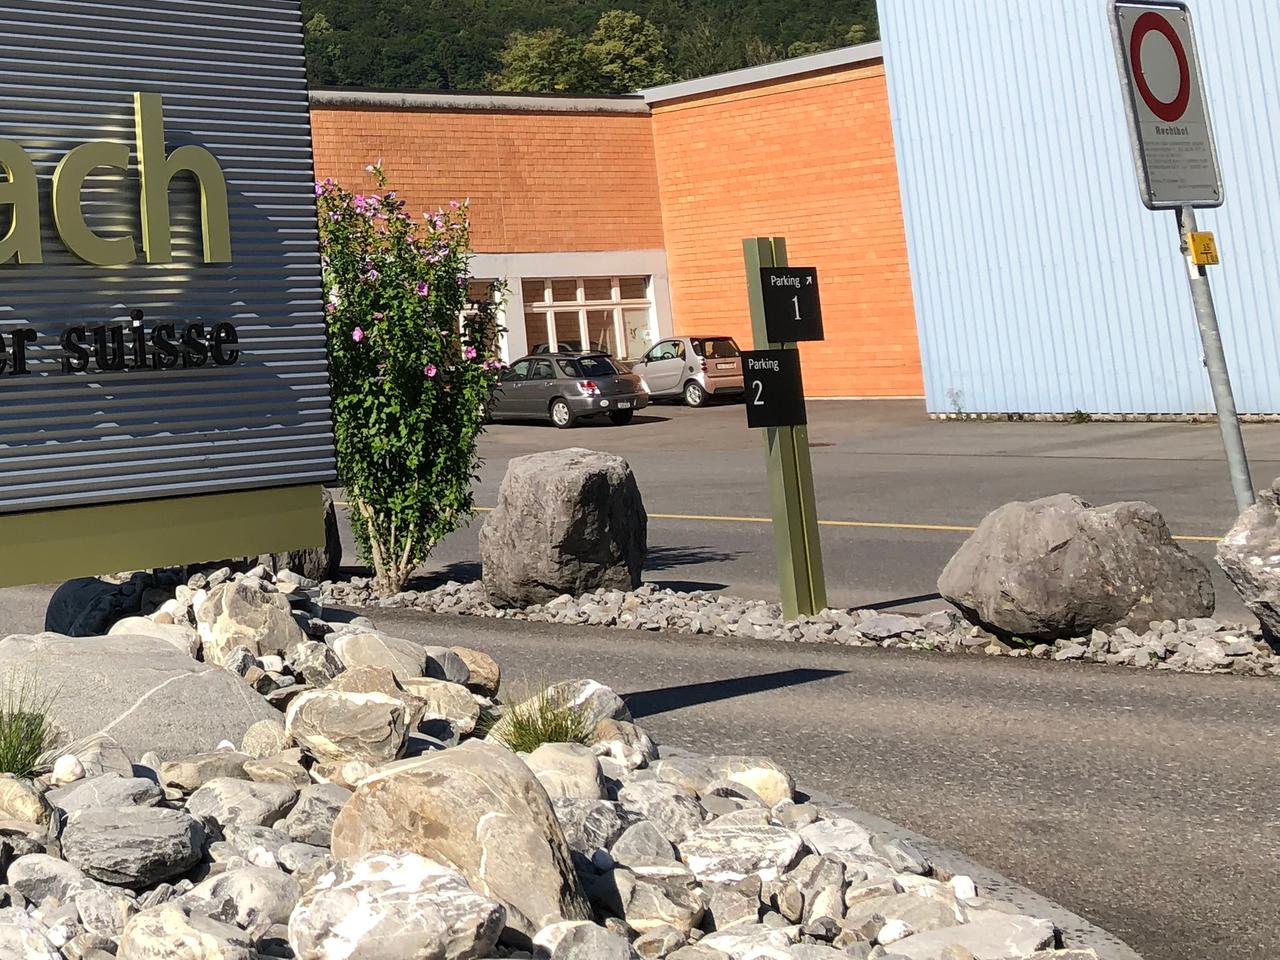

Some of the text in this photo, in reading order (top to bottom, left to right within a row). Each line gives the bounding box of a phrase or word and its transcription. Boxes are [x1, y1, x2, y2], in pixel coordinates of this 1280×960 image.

[770, 275, 801, 289] Parking
[791, 295, 802, 321] 1
[60, 308, 240, 374] suisse
[748, 358, 780, 372] Parking
[752, 380, 765, 405] 2
